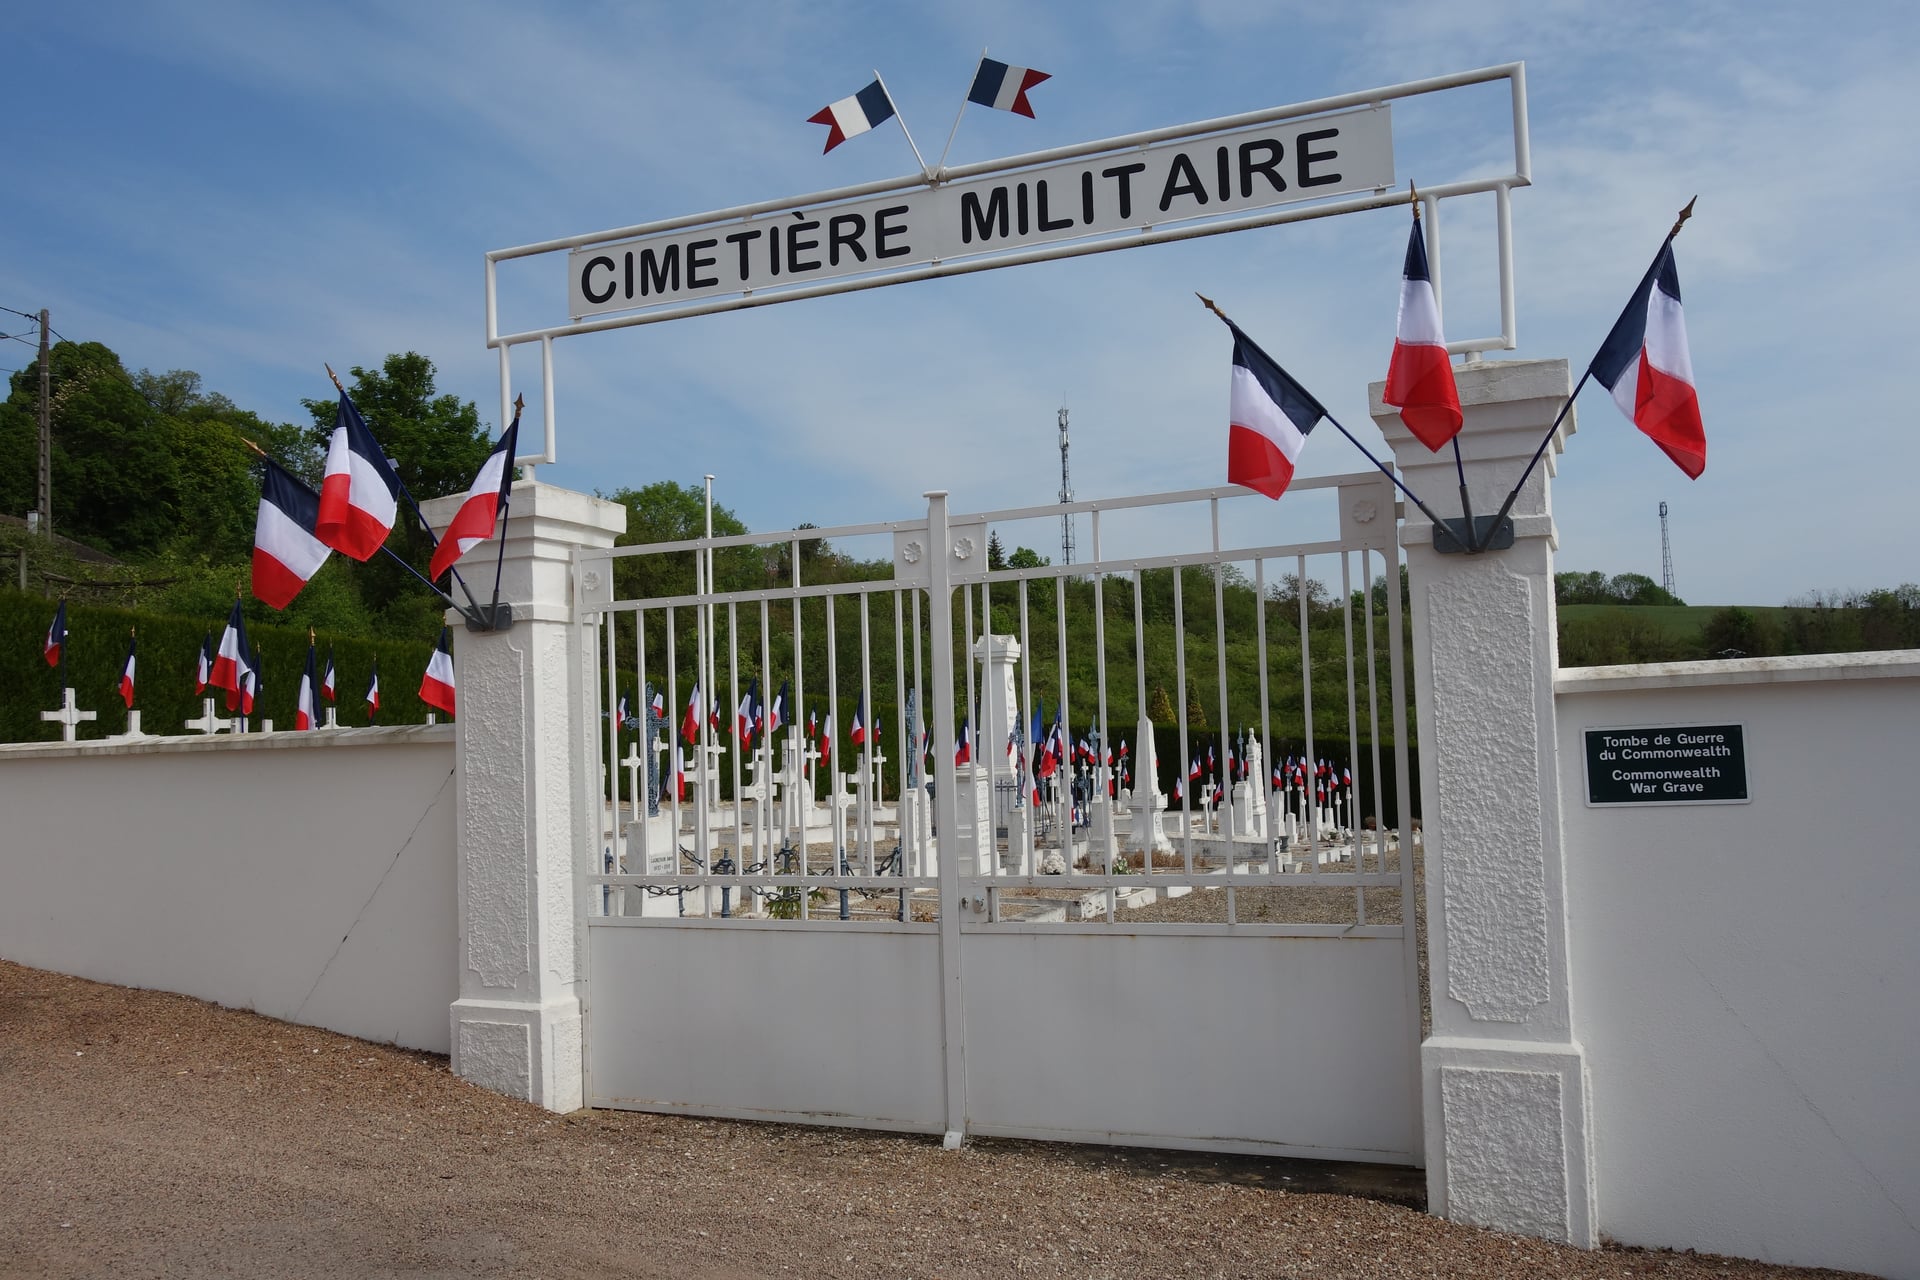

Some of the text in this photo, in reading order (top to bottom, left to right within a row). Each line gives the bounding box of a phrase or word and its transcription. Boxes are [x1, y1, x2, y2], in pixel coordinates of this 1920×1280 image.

[581, 128, 1343, 304] CIMETIÈRE MILITAIRE
[1603, 733, 1724, 747] Tombe de Guerre
[1599, 745, 1731, 761] du Commonwealth
[1612, 766, 1721, 781] Commonwealth
[1630, 781, 1704, 794] War Grave
